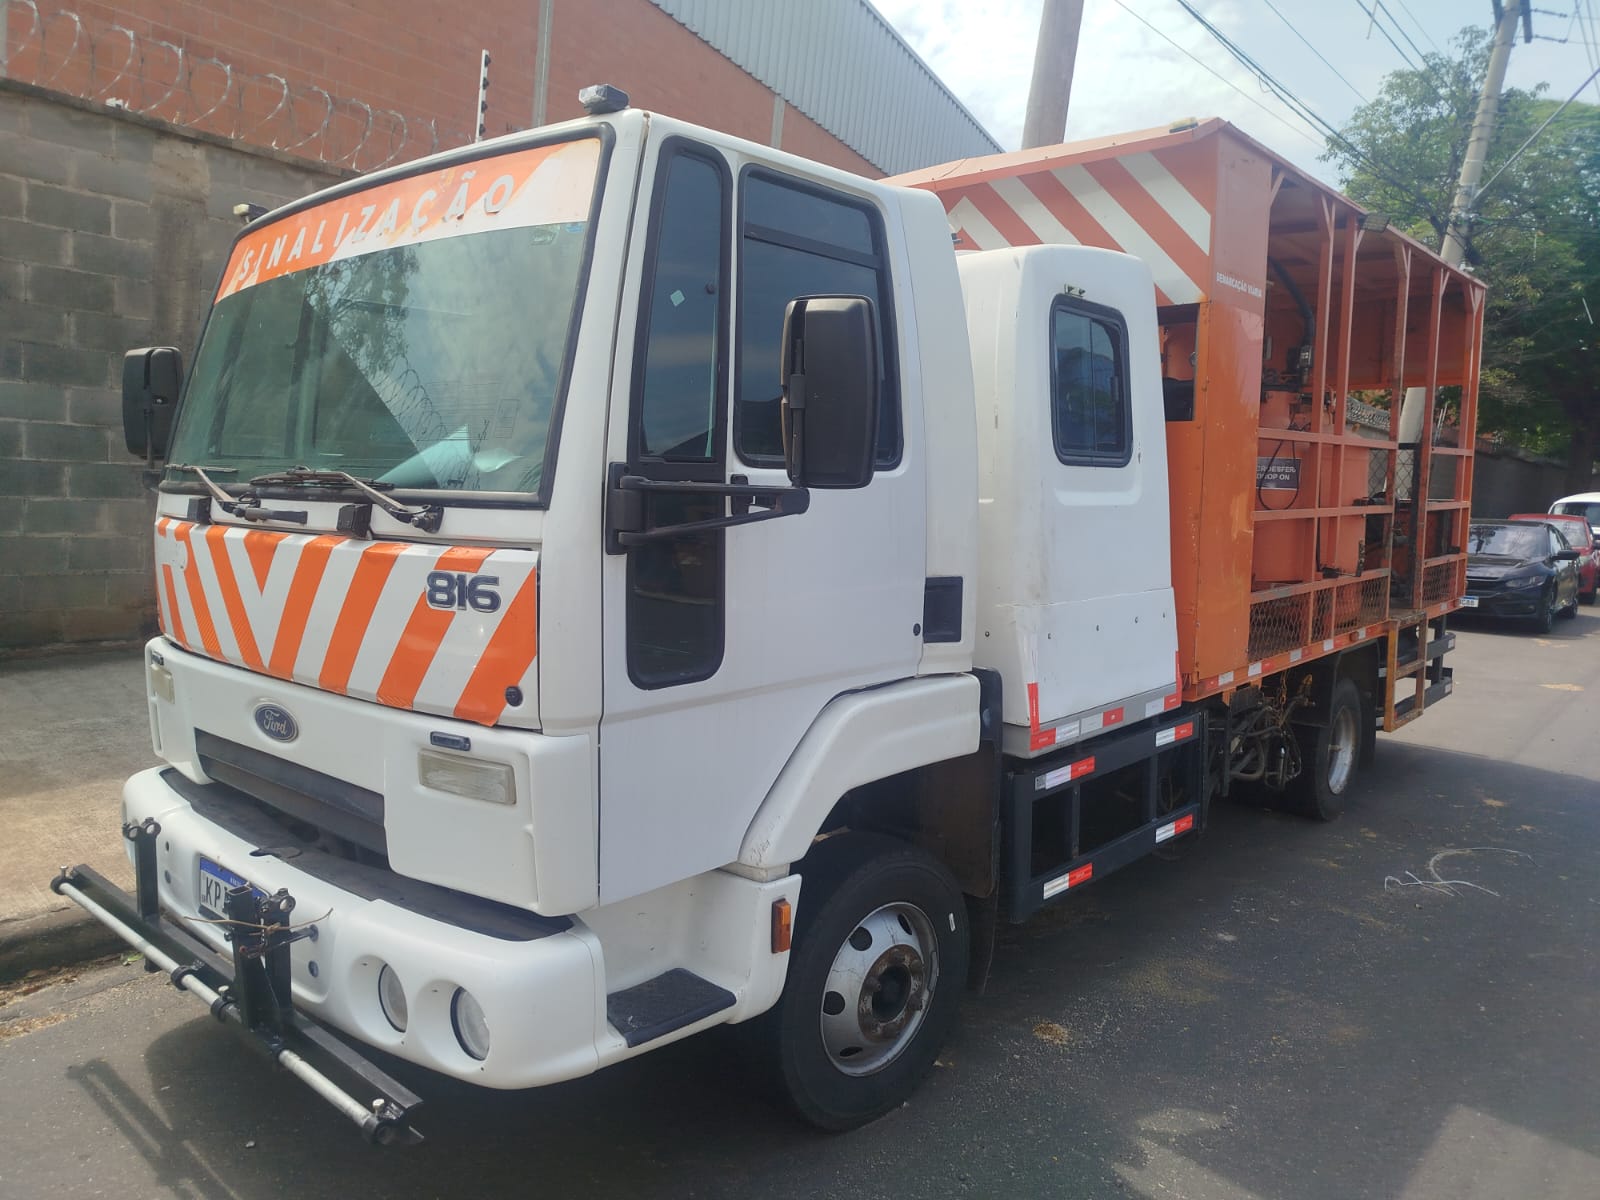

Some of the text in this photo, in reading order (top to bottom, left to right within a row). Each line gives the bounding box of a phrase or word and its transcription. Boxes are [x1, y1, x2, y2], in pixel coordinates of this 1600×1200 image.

[238, 170, 514, 283] SINALIZAÇÃO
[426, 570, 502, 614] 816
[264, 709, 288, 735] Ford
[206, 876, 228, 909] KP
